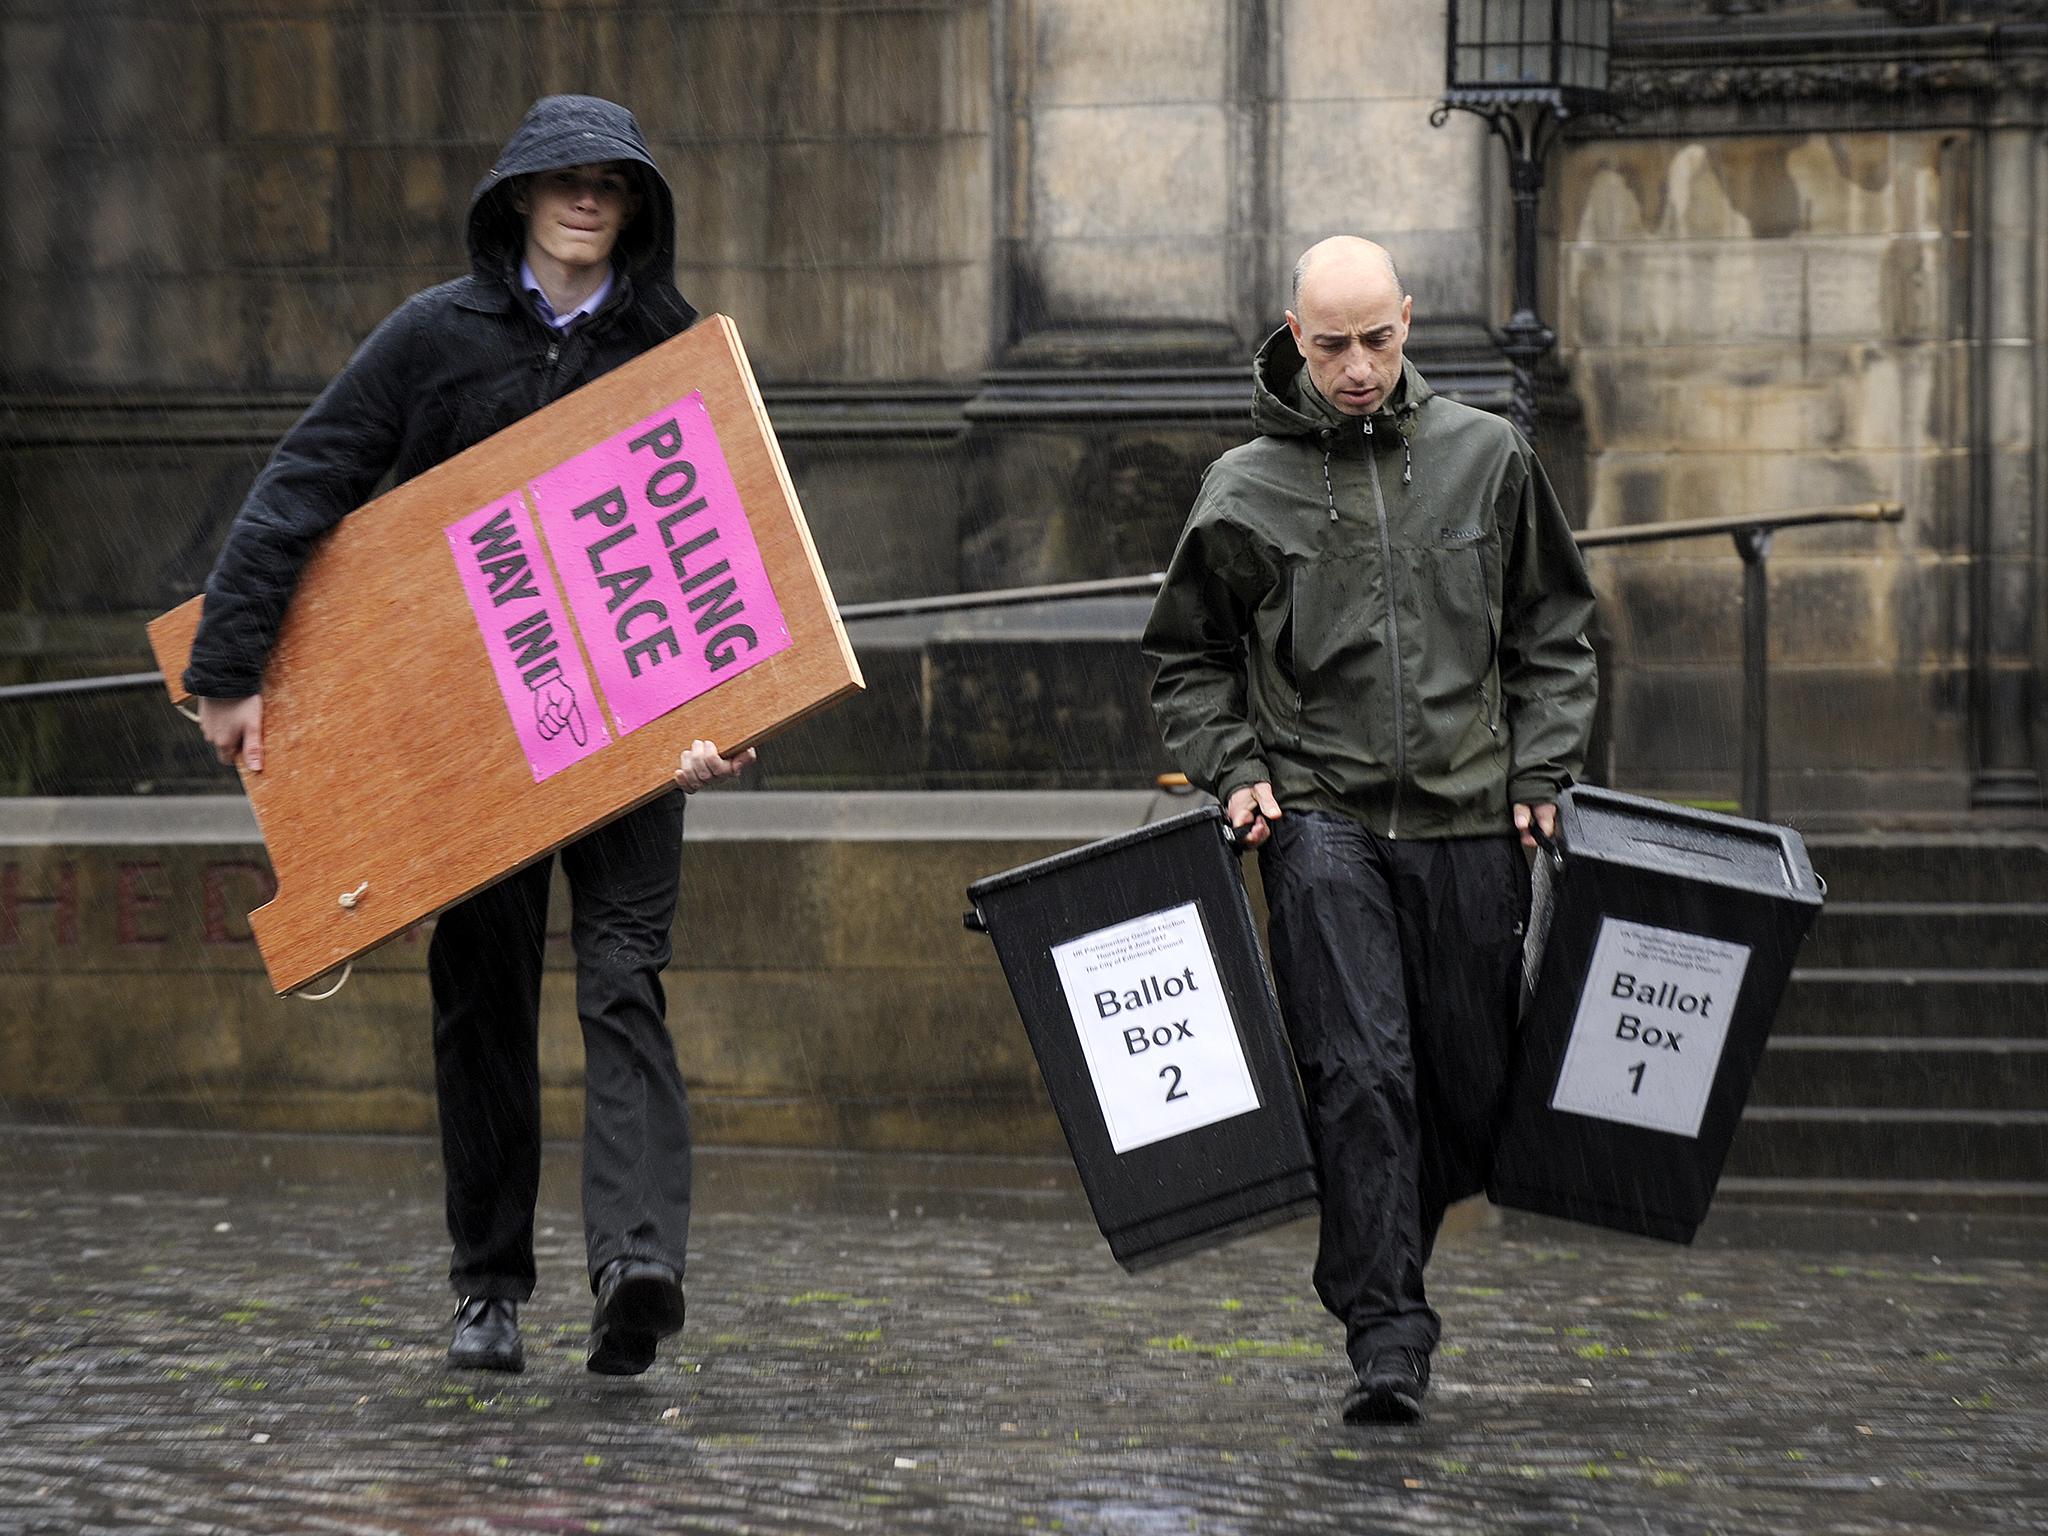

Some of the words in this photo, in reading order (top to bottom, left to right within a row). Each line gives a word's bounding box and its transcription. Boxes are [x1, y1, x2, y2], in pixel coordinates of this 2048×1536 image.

[469, 507, 541, 608] WAY
[627, 417, 758, 673] POLLING
[571, 485, 682, 679] PLACE
[504, 609, 560, 669] IN
[1094, 966, 1198, 1019] Ballot
[1611, 971, 1713, 1018] Ballot
[1122, 1018, 1194, 1056] Box
[1615, 1013, 1684, 1054] Box
[1158, 1064, 1189, 1103] 2
[1627, 1059, 1648, 1096] 1
